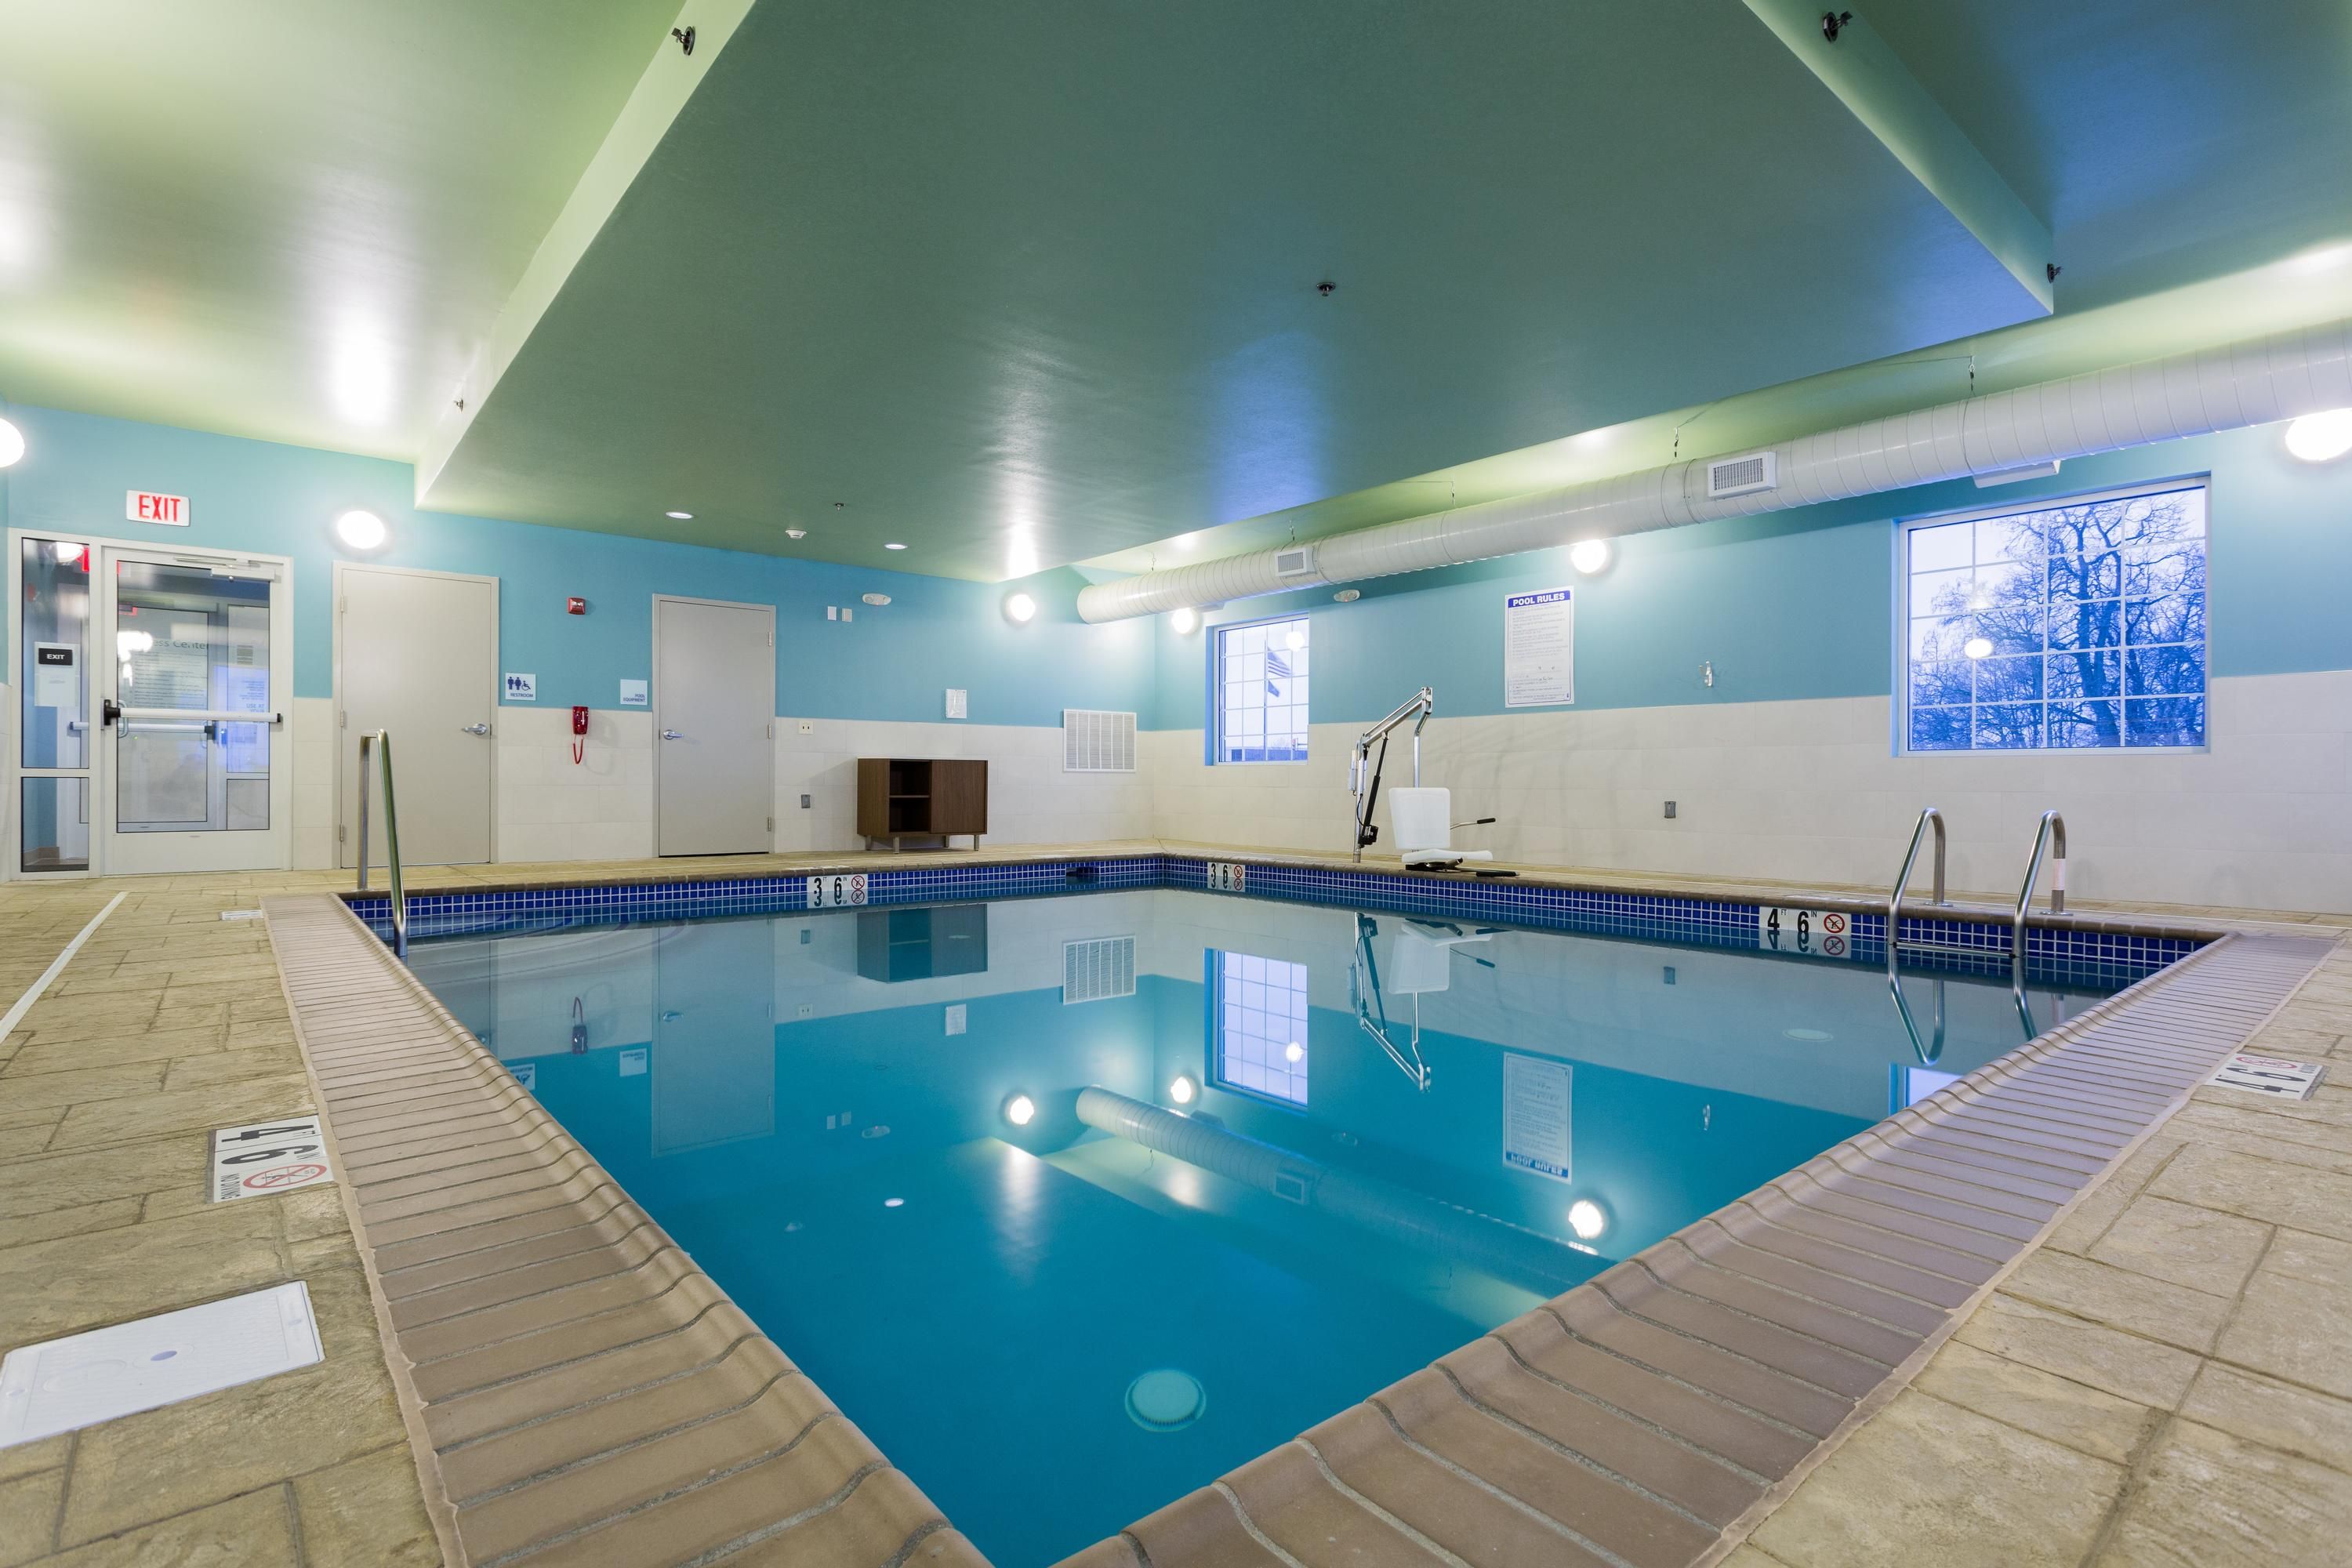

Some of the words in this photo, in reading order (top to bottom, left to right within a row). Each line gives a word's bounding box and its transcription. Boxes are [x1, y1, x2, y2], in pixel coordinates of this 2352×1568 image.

[139, 494, 181, 522] EXIT
[1512, 597, 1535, 607] POOL
[1537, 593, 1565, 603] RULES
[1211, 863, 1216, 877] 3
[1223, 865, 1228, 877] 6
[814, 877, 822, 892] 3
[834, 877, 842, 891] 6
[1767, 909, 1780, 931] 4
[1797, 911, 1809, 932] 6
[2226, 1067, 2307, 1082] 6
[2215, 1078, 2300, 1093] 4
[221, 1124, 314, 1142] 4
[221, 1145, 319, 1165] 6
[220, 1173, 240, 1182] NO
